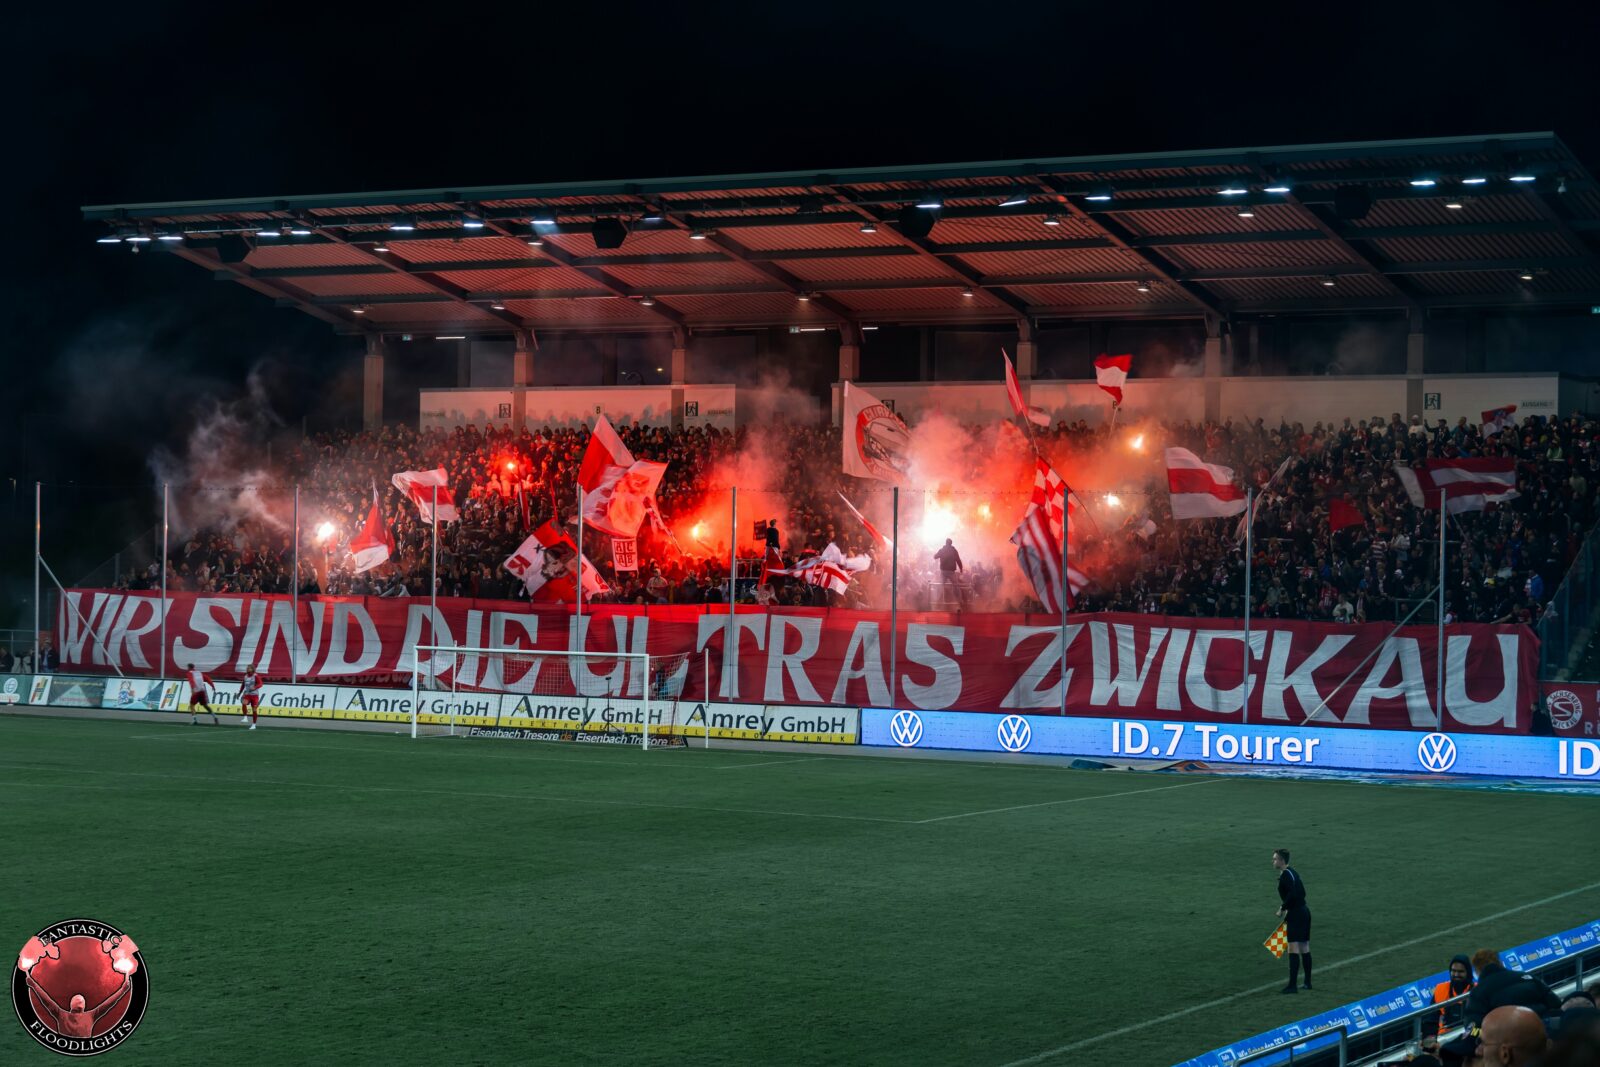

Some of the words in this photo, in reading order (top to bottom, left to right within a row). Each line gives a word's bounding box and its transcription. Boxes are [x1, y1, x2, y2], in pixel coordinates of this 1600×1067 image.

[58, 591, 174, 669] WIR
[173, 597, 382, 676] SIND
[393, 604, 543, 696] DIE
[568, 613, 966, 711] ULTRAS
[999, 620, 1520, 728] ZWICKAU
[270, 692, 325, 709] GmbH
[431, 699, 489, 717] GmbH
[511, 695, 596, 727] Amrey
[601, 707, 663, 725] GmbH
[685, 703, 774, 736] Amrey
[781, 716, 846, 733] GmbH
[470, 727, 521, 739] Eisenbach
[523, 730, 559, 741] Tresore
[576, 733, 627, 744] Eisenbach
[1112, 720, 1184, 758] ID.7
[1194, 725, 1321, 763] Tourer
